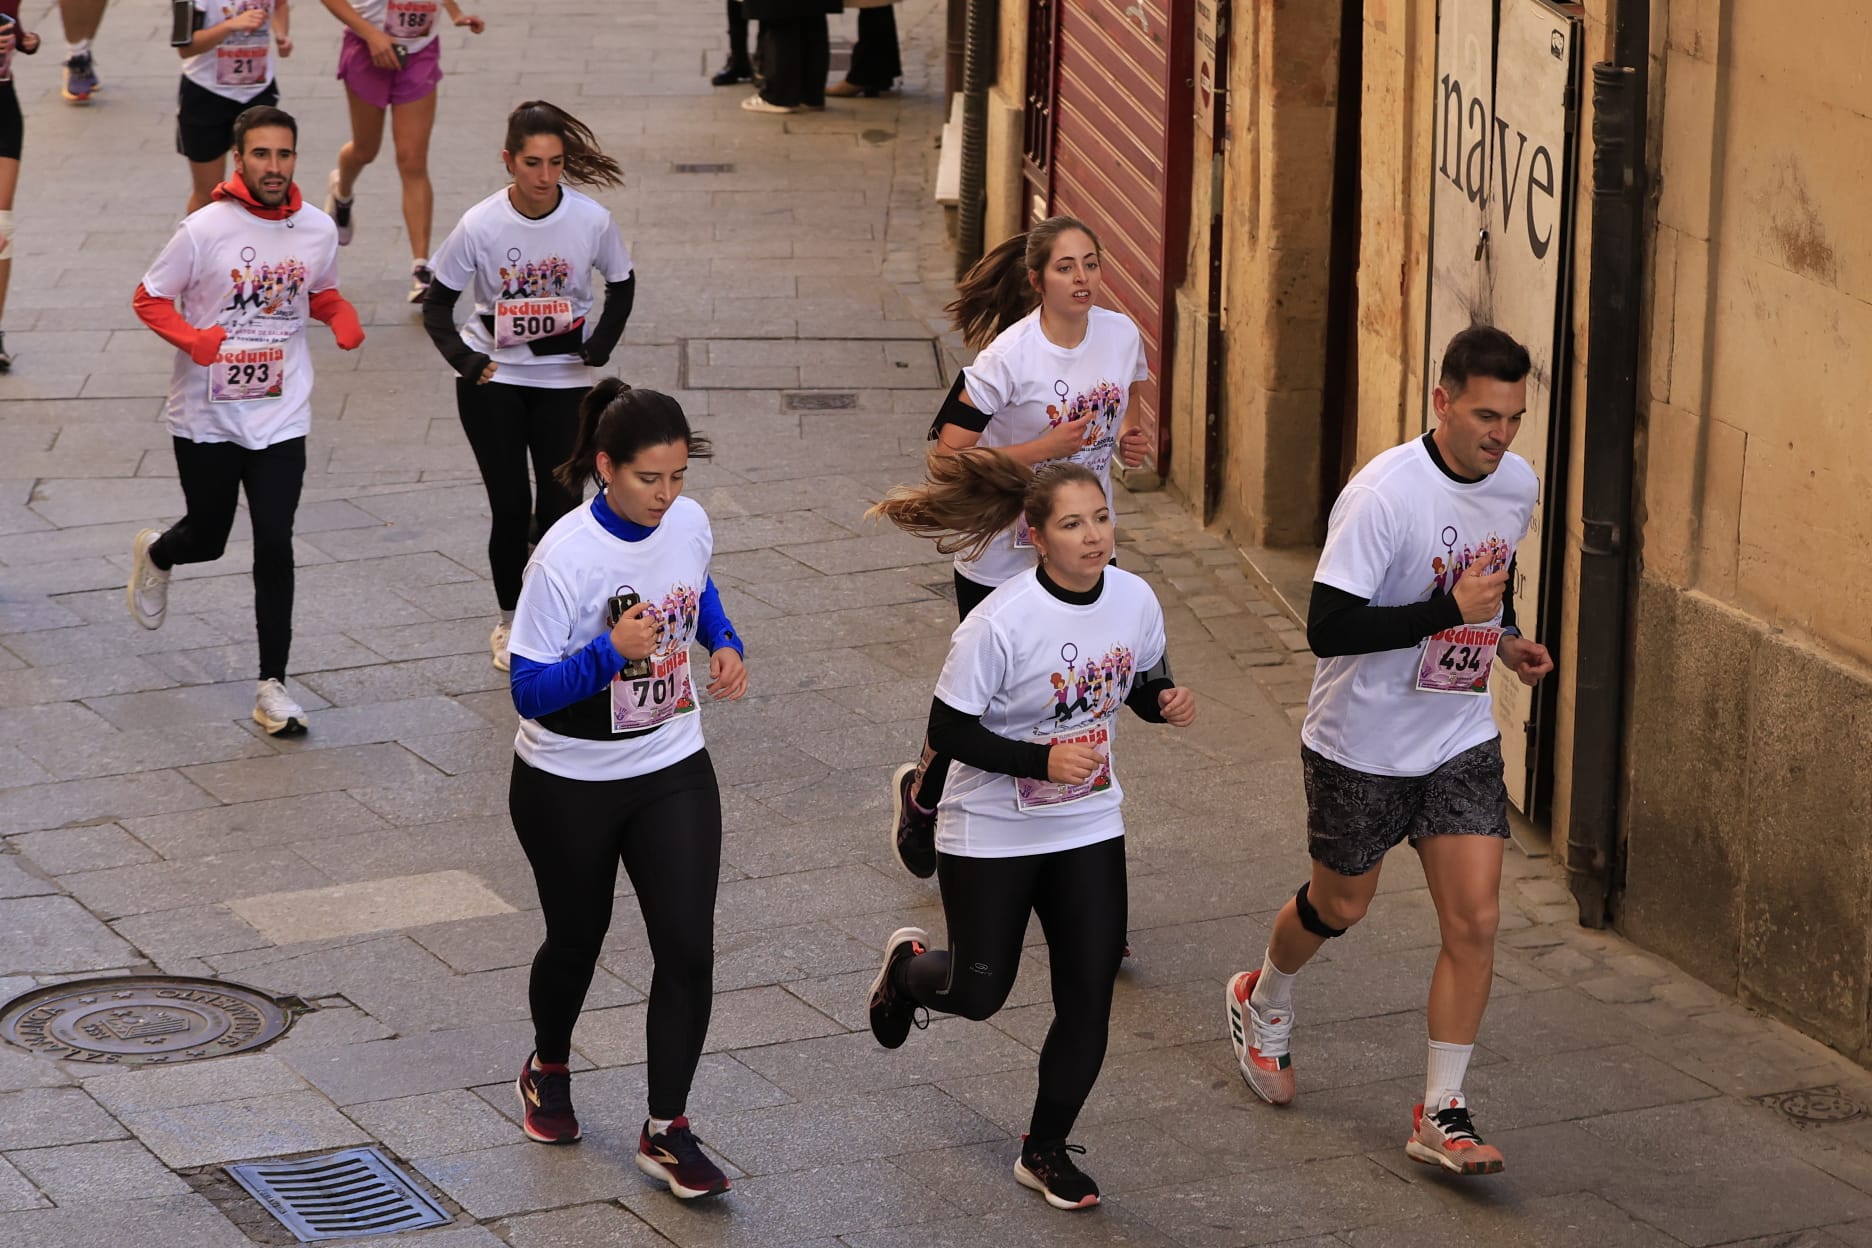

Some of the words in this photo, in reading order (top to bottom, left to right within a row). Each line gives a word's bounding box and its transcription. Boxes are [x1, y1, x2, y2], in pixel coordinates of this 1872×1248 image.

[399, 12, 427, 27] 188
[233, 59, 252, 74] 21
[1439, 73, 1554, 260] nave
[497, 300, 569, 316] bedunia
[513, 316, 555, 336] 500
[227, 363, 269, 385] 293
[1440, 645, 1481, 672] 434
[633, 672, 675, 708] 701
